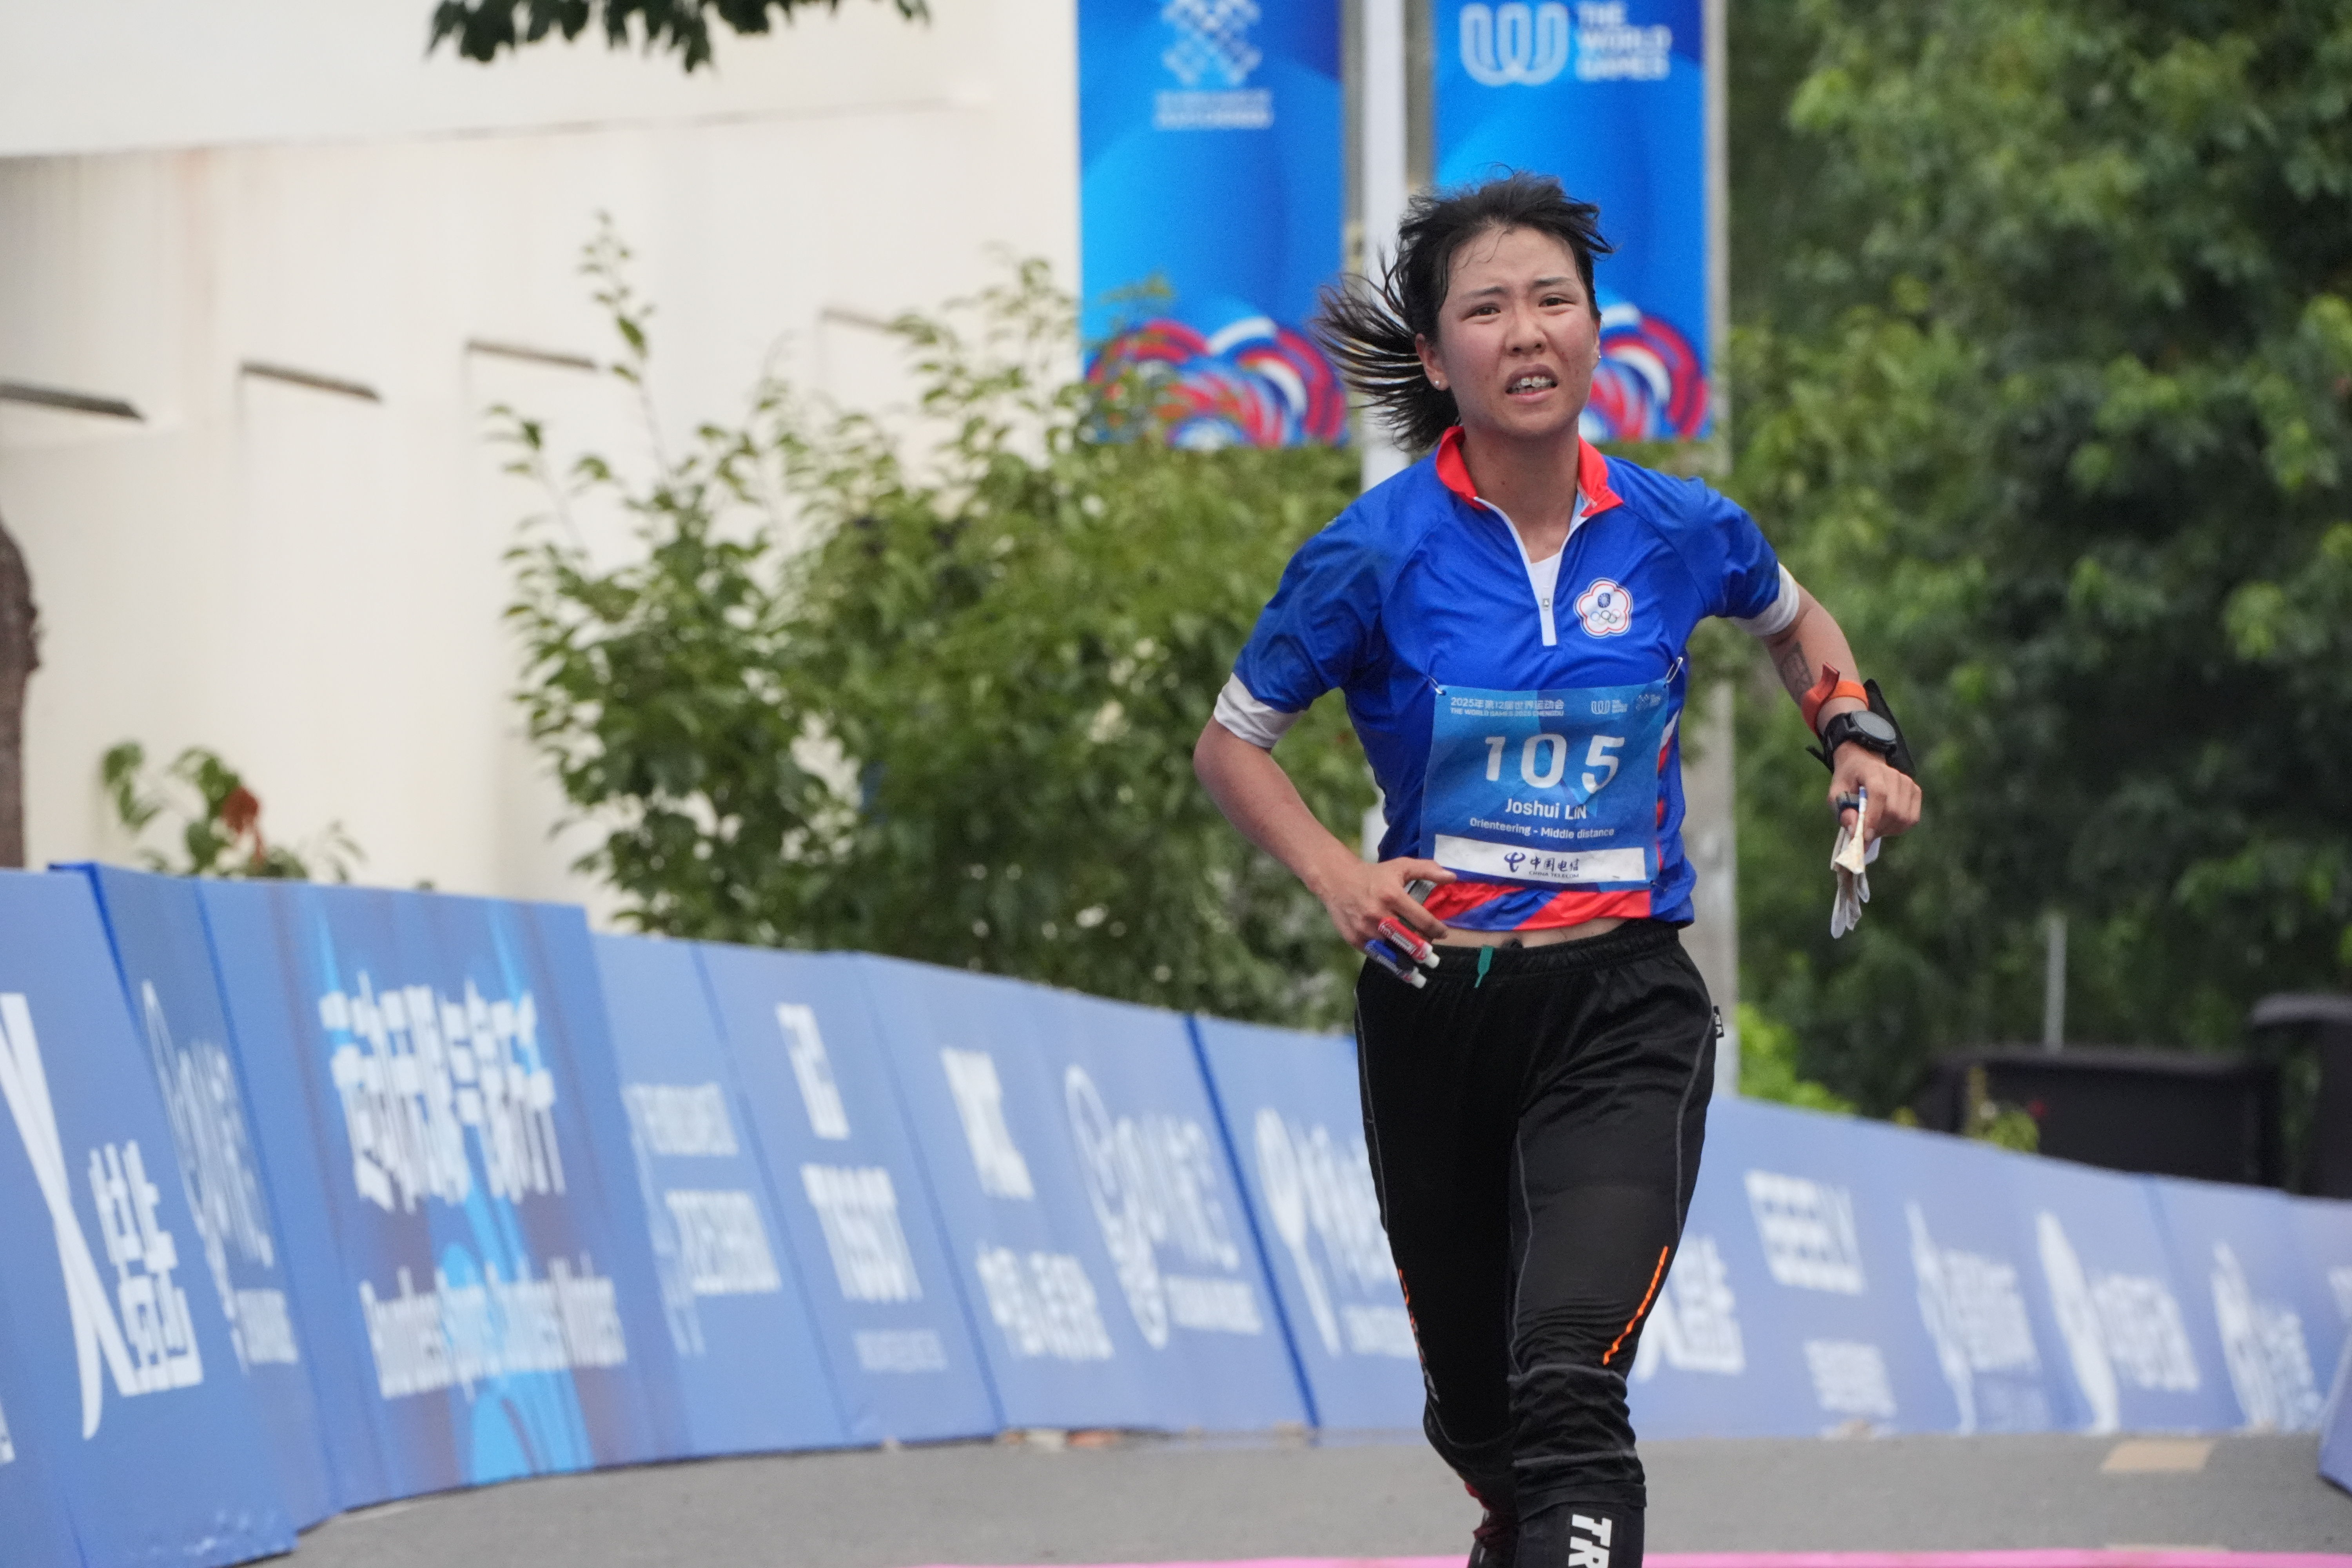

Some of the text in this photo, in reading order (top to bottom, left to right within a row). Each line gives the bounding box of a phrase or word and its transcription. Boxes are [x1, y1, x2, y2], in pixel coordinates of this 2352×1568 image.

[1485, 734, 1625, 793] 105
[1505, 798, 1587, 820] Joshui LIN
[1470, 817, 1532, 836] Orienteering
[1540, 827, 1575, 839] Middle
[1577, 829, 1615, 839] distance
[1530, 856, 1580, 872] 中国电信
